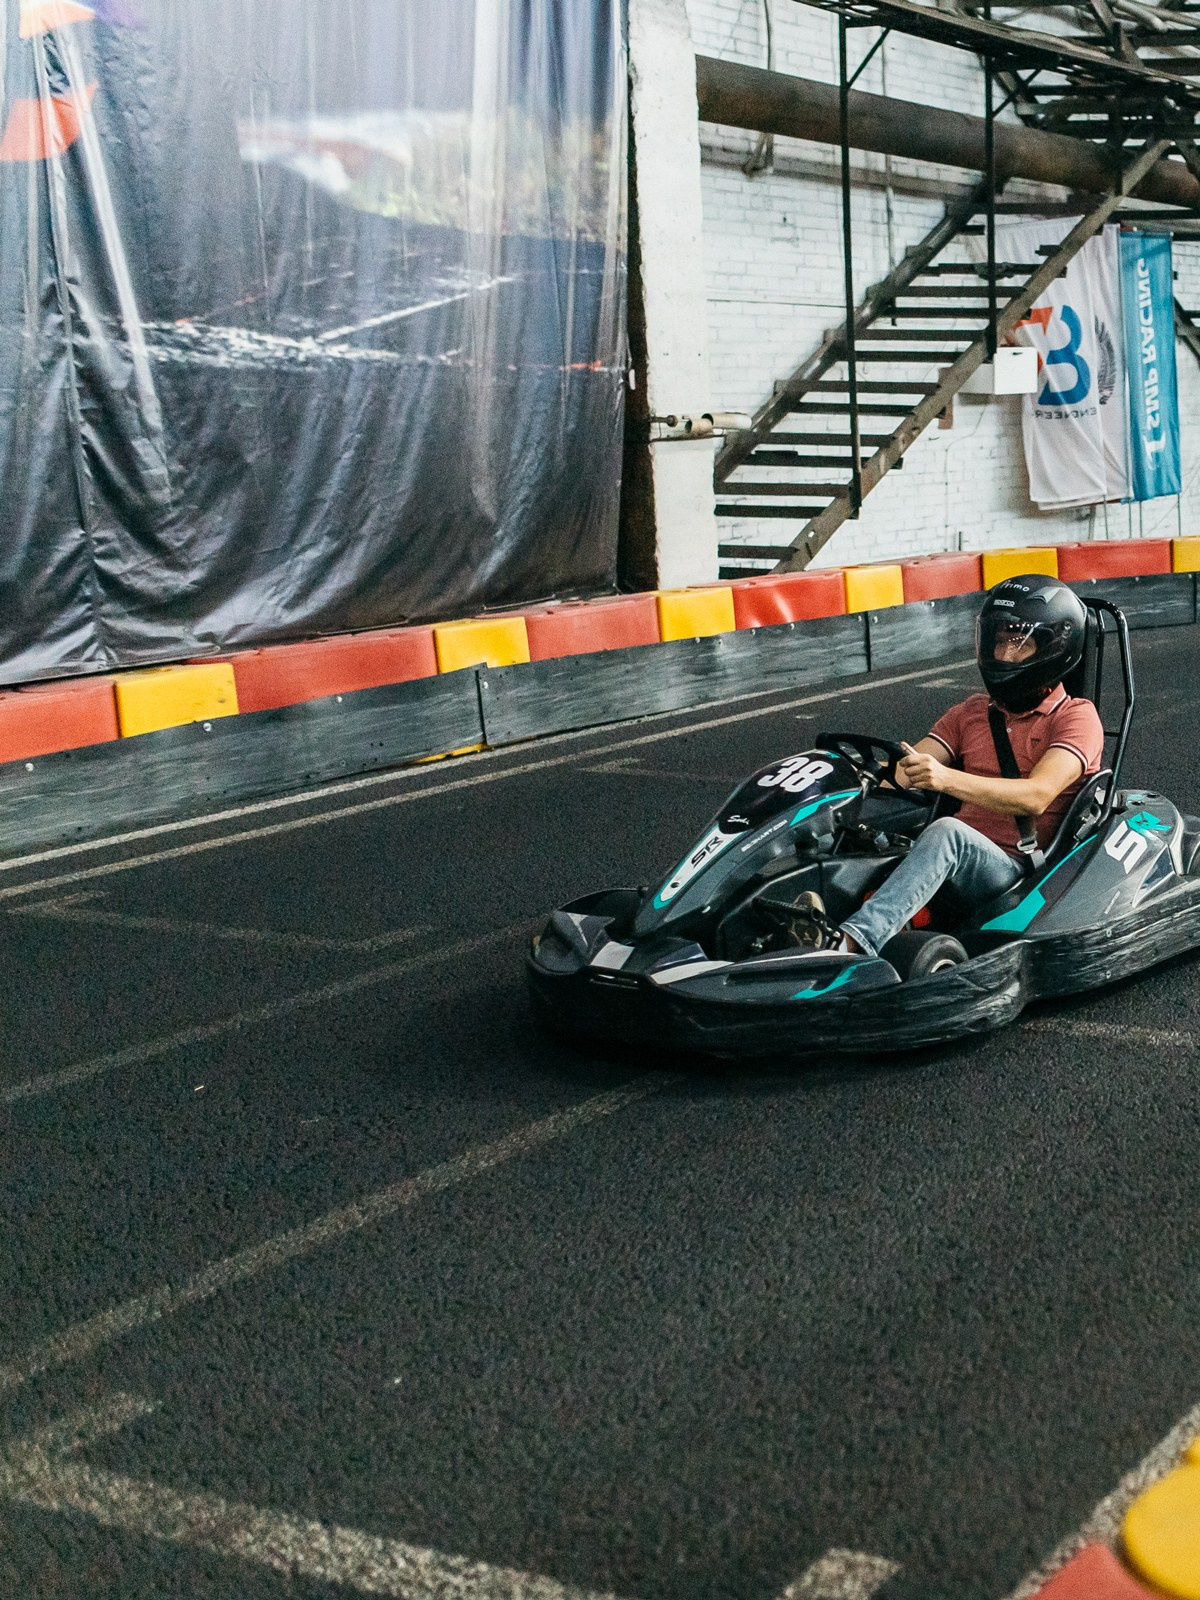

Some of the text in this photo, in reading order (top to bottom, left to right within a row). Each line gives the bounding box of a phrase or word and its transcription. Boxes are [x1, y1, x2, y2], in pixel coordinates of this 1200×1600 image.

[757, 757, 834, 793] 38
[691, 836, 724, 869] SR
[1104, 811, 1171, 875] SR
